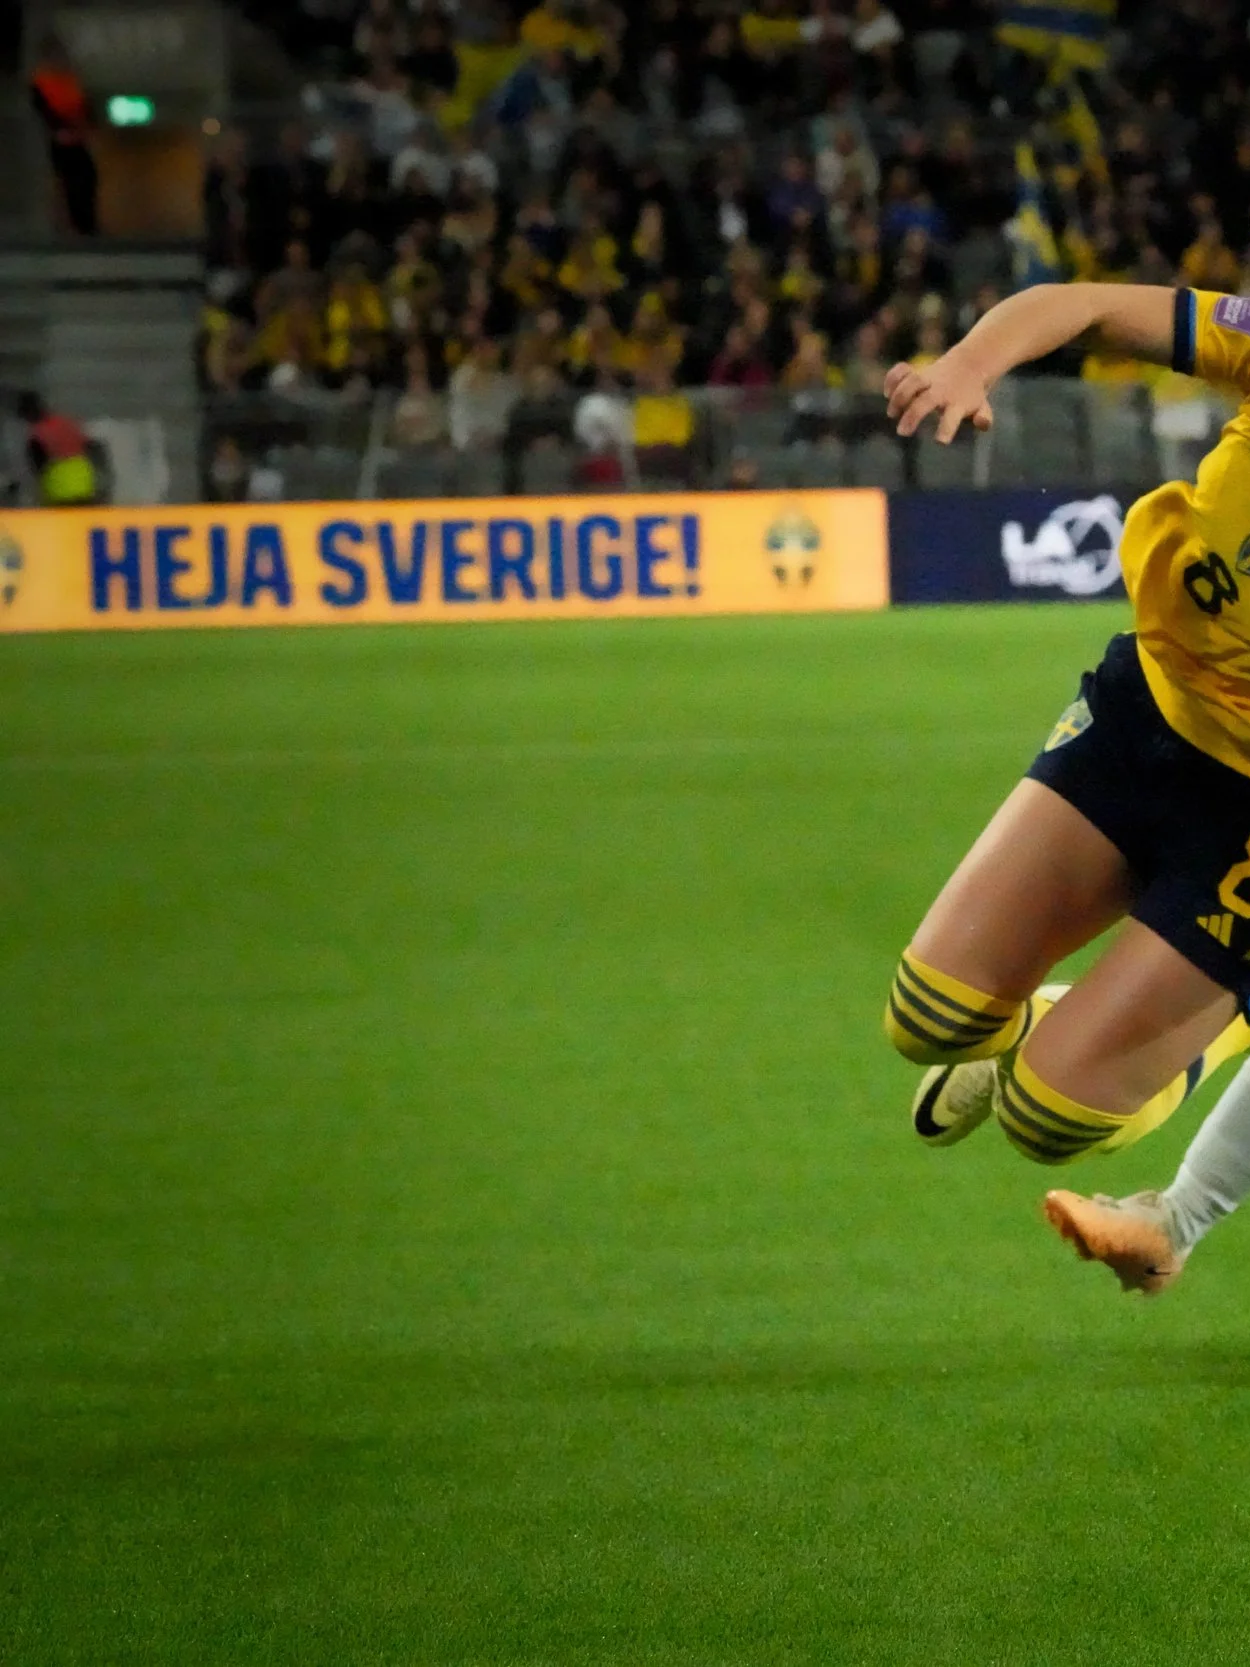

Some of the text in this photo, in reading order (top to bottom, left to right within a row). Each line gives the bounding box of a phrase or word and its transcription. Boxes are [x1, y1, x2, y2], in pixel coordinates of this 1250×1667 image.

[89, 515, 702, 610] HEJA SVERIGE!
[1184, 551, 1239, 616] 8
